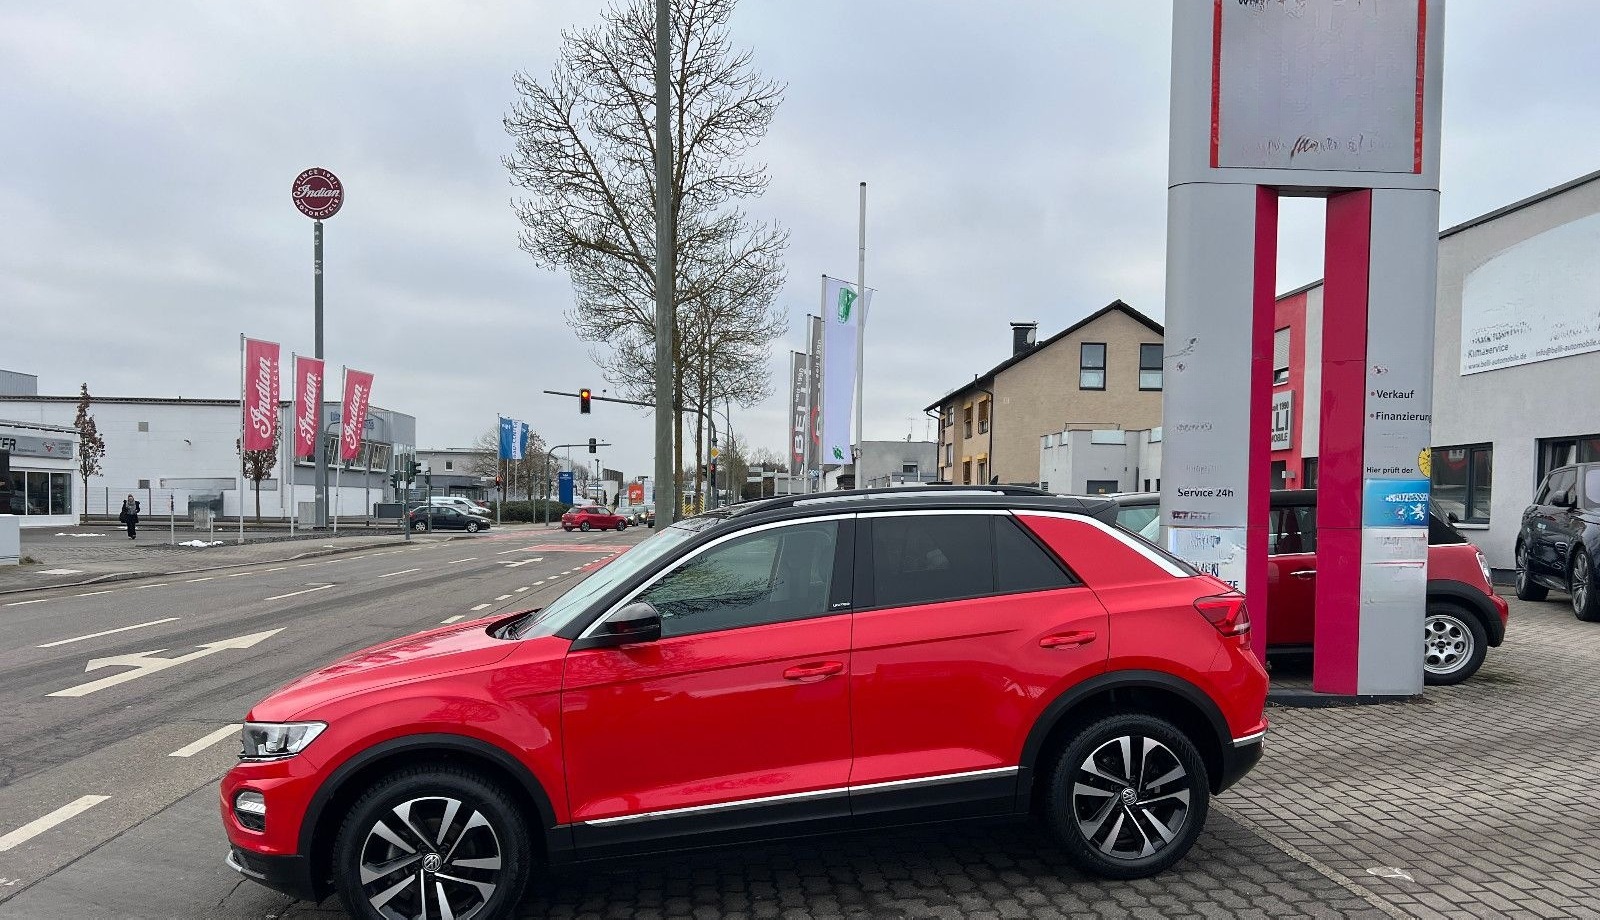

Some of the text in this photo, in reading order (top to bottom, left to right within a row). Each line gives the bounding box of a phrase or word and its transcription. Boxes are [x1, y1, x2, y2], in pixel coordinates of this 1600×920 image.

[296, 169, 318, 184] SINCE
[293, 185, 340, 198] Indian
[295, 198, 339, 216] MOTORCYCLE
[250, 356, 271, 438] Indian
[1376, 389, 1415, 399] Verkauf
[298, 372, 317, 445] Indian
[344, 383, 362, 449] Indian
[1271, 410, 1289, 432] LI
[1366, 466, 1381, 474] Hier
[1382, 466, 1400, 475] prüft
[1177, 488, 1234, 497] Service 24h
